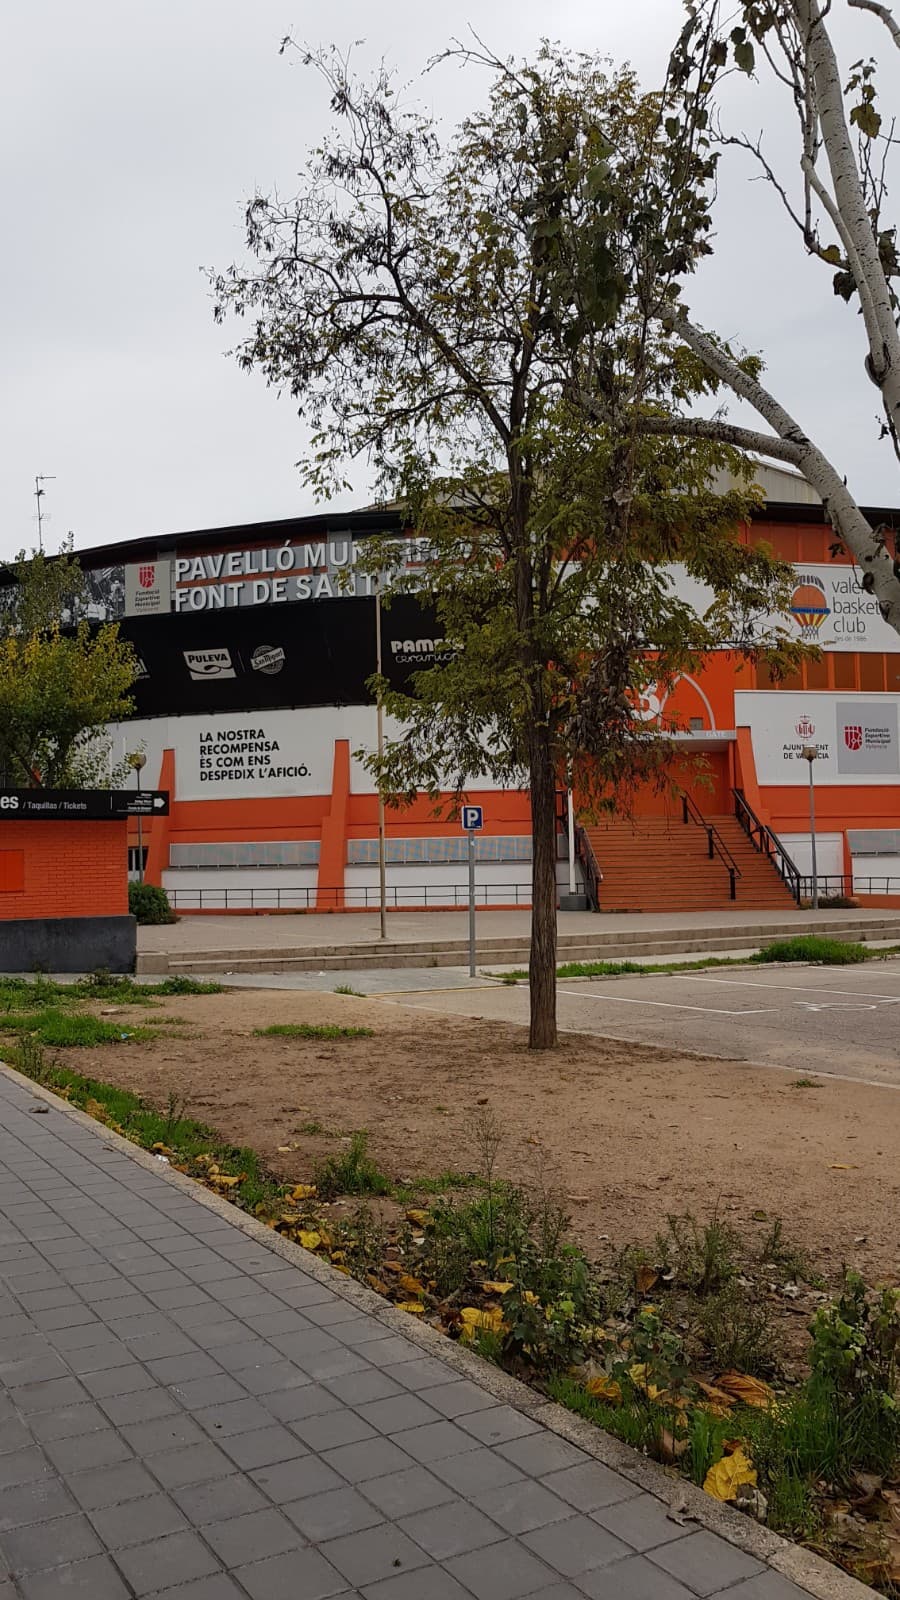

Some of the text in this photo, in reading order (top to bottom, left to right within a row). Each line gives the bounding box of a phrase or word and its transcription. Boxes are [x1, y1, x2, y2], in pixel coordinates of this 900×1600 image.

[176, 538, 296, 582] PAVELLÓ
[176, 582, 245, 612] FONT
[252, 577, 289, 604] DE
[833, 616, 866, 633] club
[188, 653, 228, 664] PULEVA
[200, 729, 266, 742] LA NOSTRA
[200, 741, 280, 755] RECOMPENSA
[200, 755, 271, 768] ÉS COM ENS
[200, 769, 255, 781] DESPEDIX
[0, 796, 19, 809] es
[28, 801, 57, 810] Taquillas
[64, 802, 87, 810] Tickets
[467, 809, 479, 827] P
